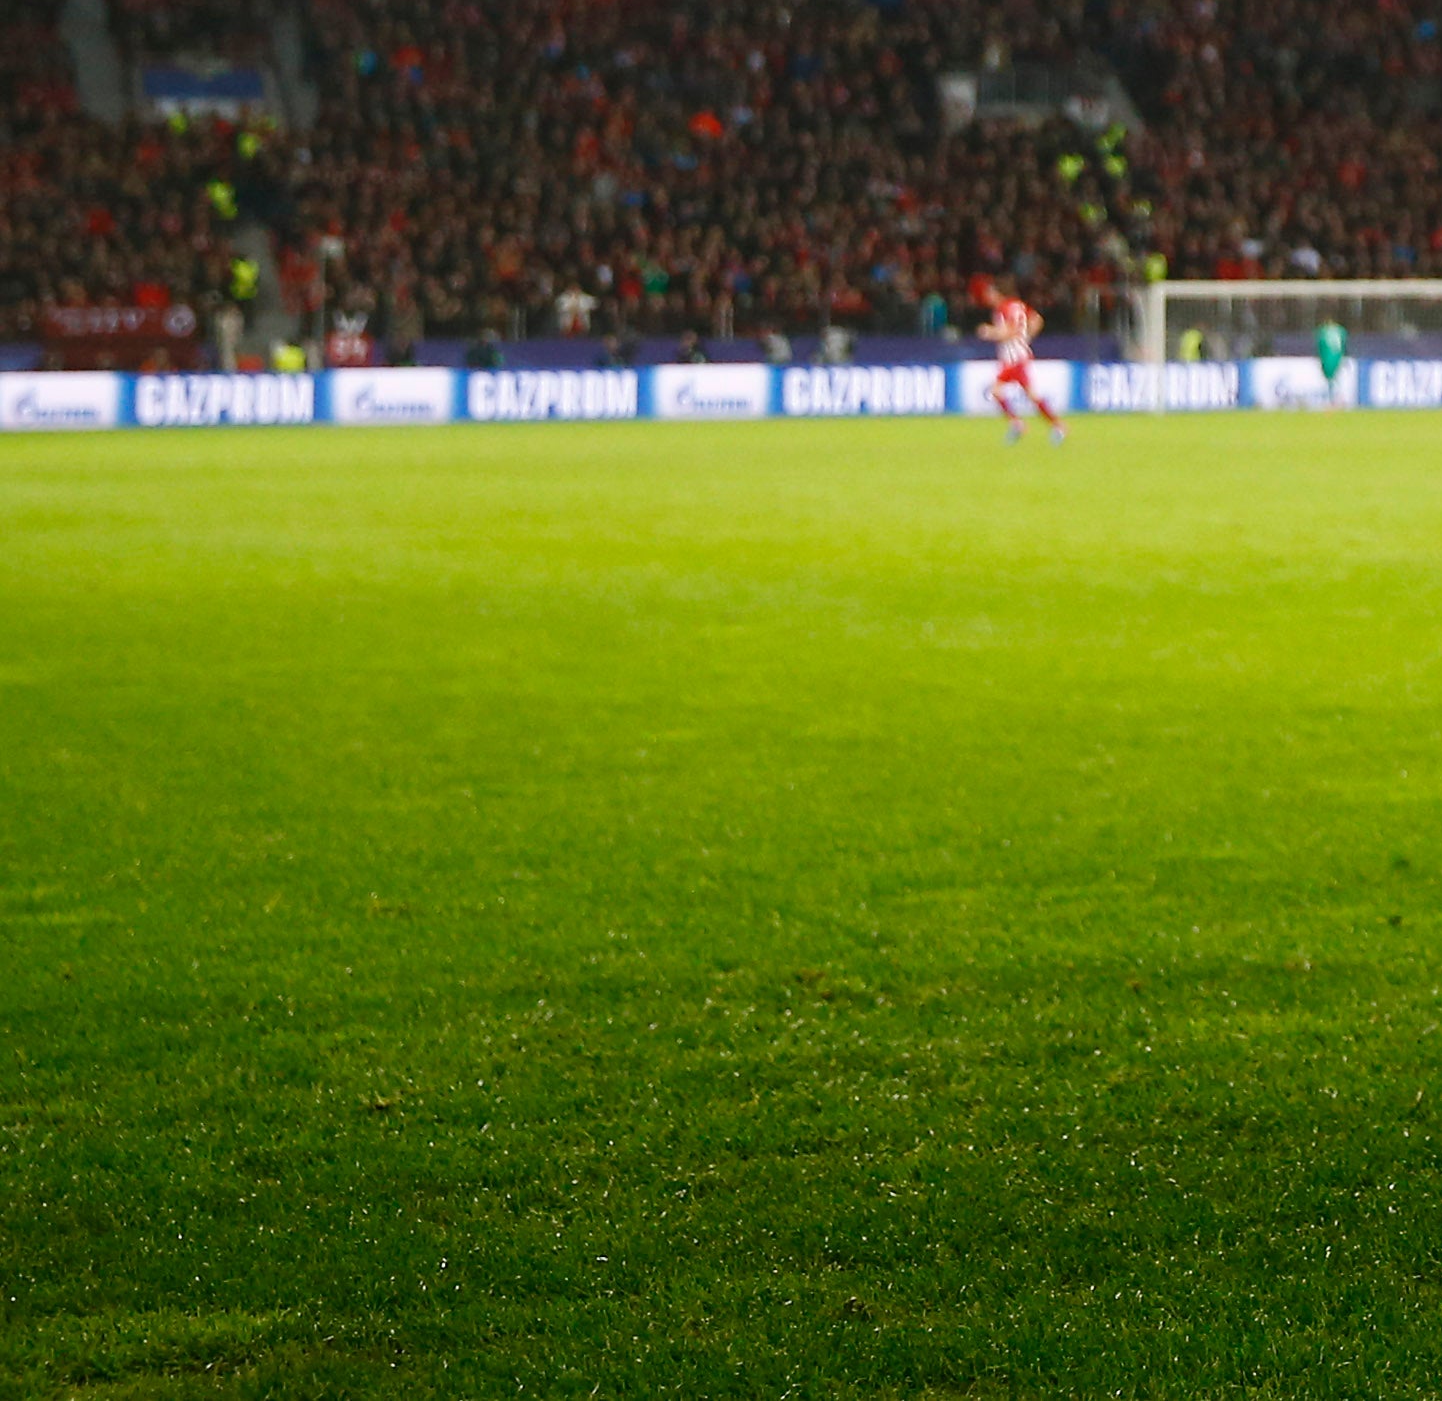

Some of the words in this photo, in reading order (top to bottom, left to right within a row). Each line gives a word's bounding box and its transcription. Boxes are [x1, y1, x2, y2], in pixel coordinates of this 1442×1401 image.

[136, 374, 314, 426] GAZPROM
[468, 369, 638, 421] GAZPROM
[783, 365, 946, 417] GAZPROM
